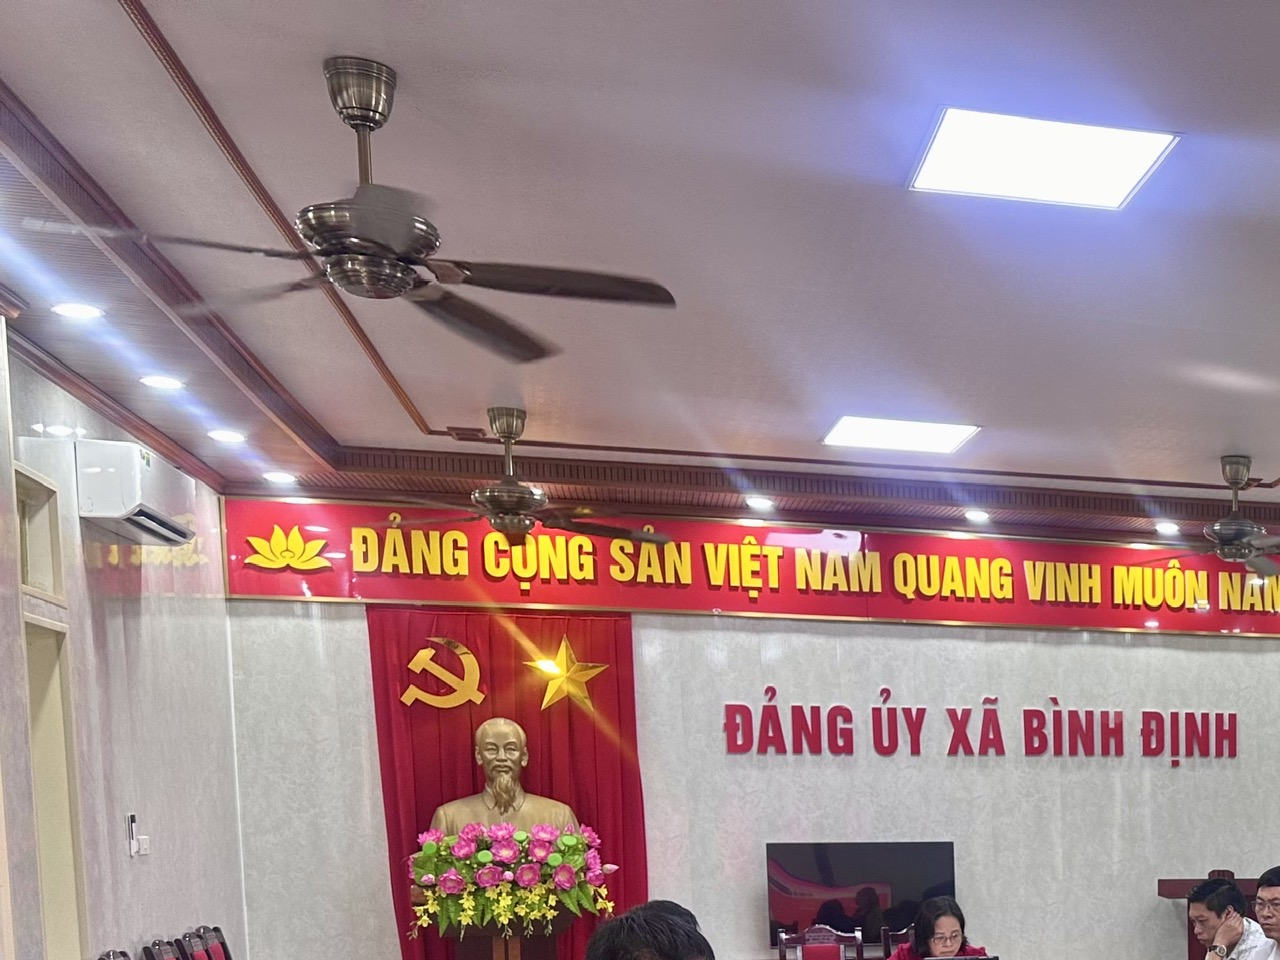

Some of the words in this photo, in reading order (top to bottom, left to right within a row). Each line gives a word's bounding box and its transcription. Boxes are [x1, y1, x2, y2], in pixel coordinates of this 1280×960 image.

[350, 512, 469, 576] ĐẢNG
[609, 524, 692, 584] SẢN
[703, 535, 783, 598] VIỆT
[795, 548, 882, 593] NAM
[893, 552, 1013, 600] QUANG
[1024, 560, 1101, 604] VINH
[1113, 559, 1208, 610] MUÔN
[723, 685, 854, 756] ĐẢNG
[871, 687, 927, 756] ỦY
[946, 696, 1006, 756] XÃ
[1023, 696, 1125, 758] BÌNH
[1140, 710, 1238, 768] ĐỊNH
